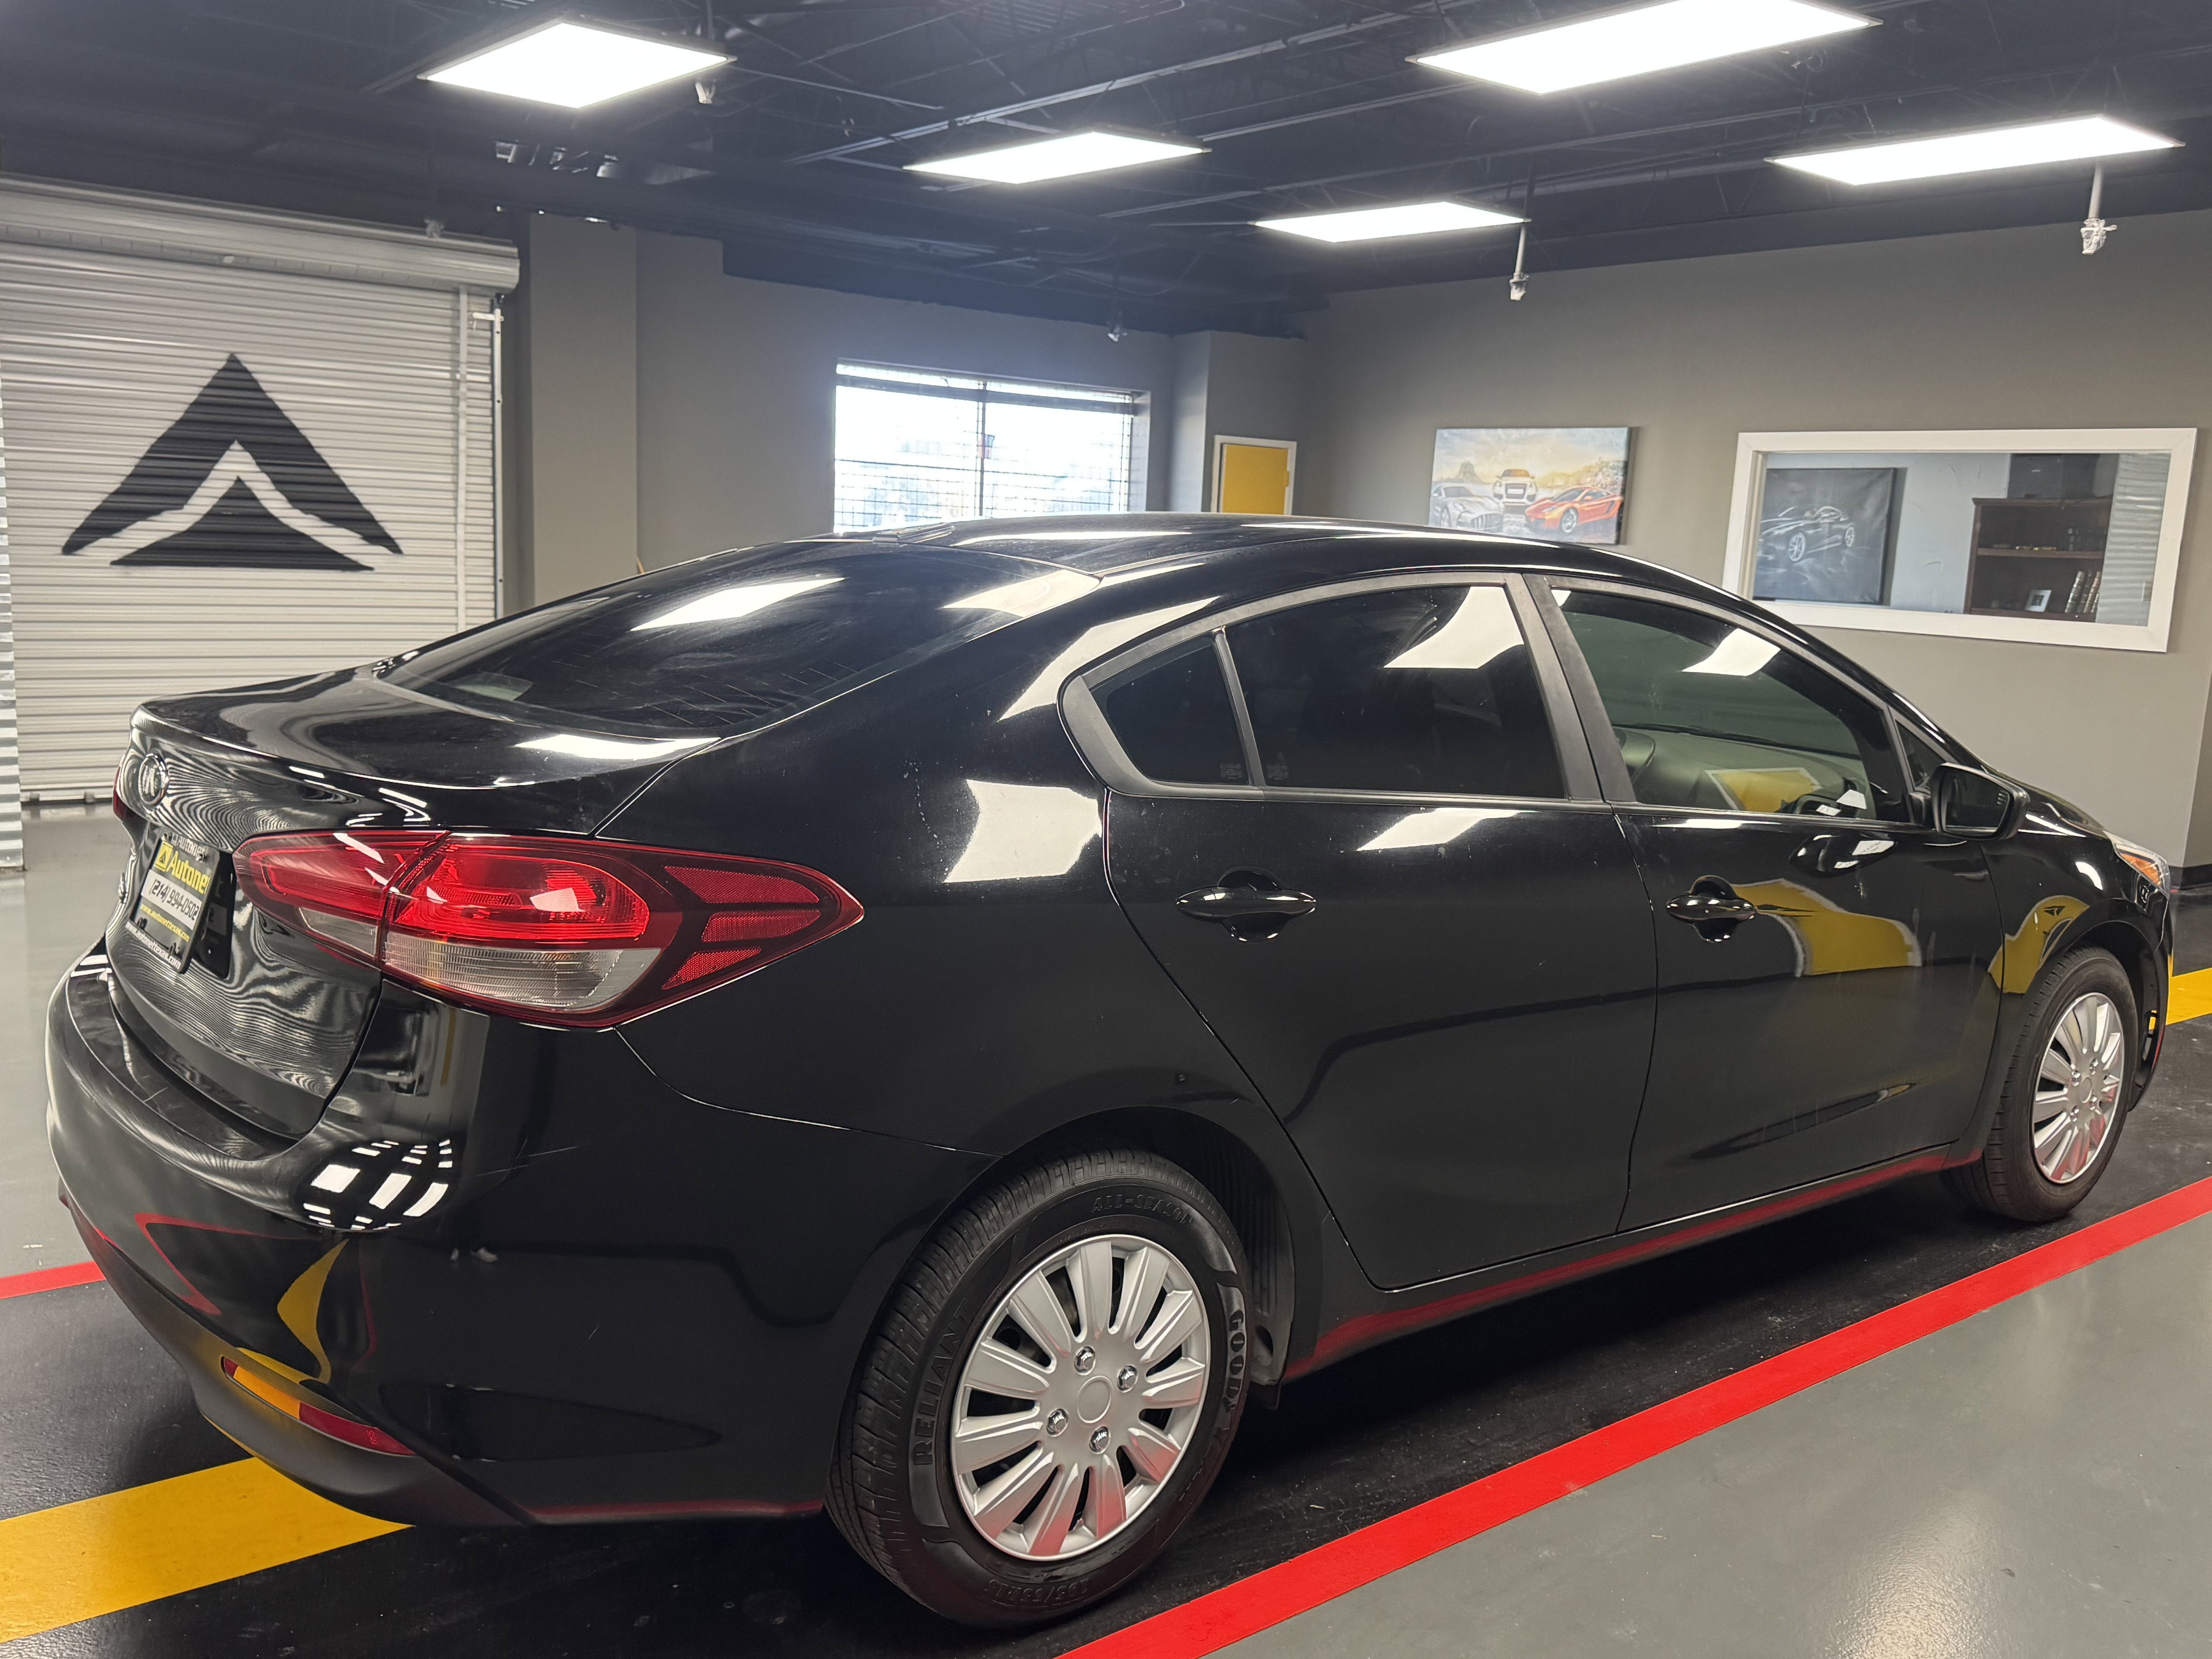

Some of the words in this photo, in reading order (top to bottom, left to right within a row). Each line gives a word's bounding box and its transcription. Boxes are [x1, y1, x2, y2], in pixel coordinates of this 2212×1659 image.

[149, 879, 171, 903] (214)
[167, 889, 199, 921] 994-0502
[140, 904, 190, 942] www.autonettexas.com
[1091, 1194, 1194, 1228] ALL-SEASON
[913, 1298, 969, 1465] RELIANT
